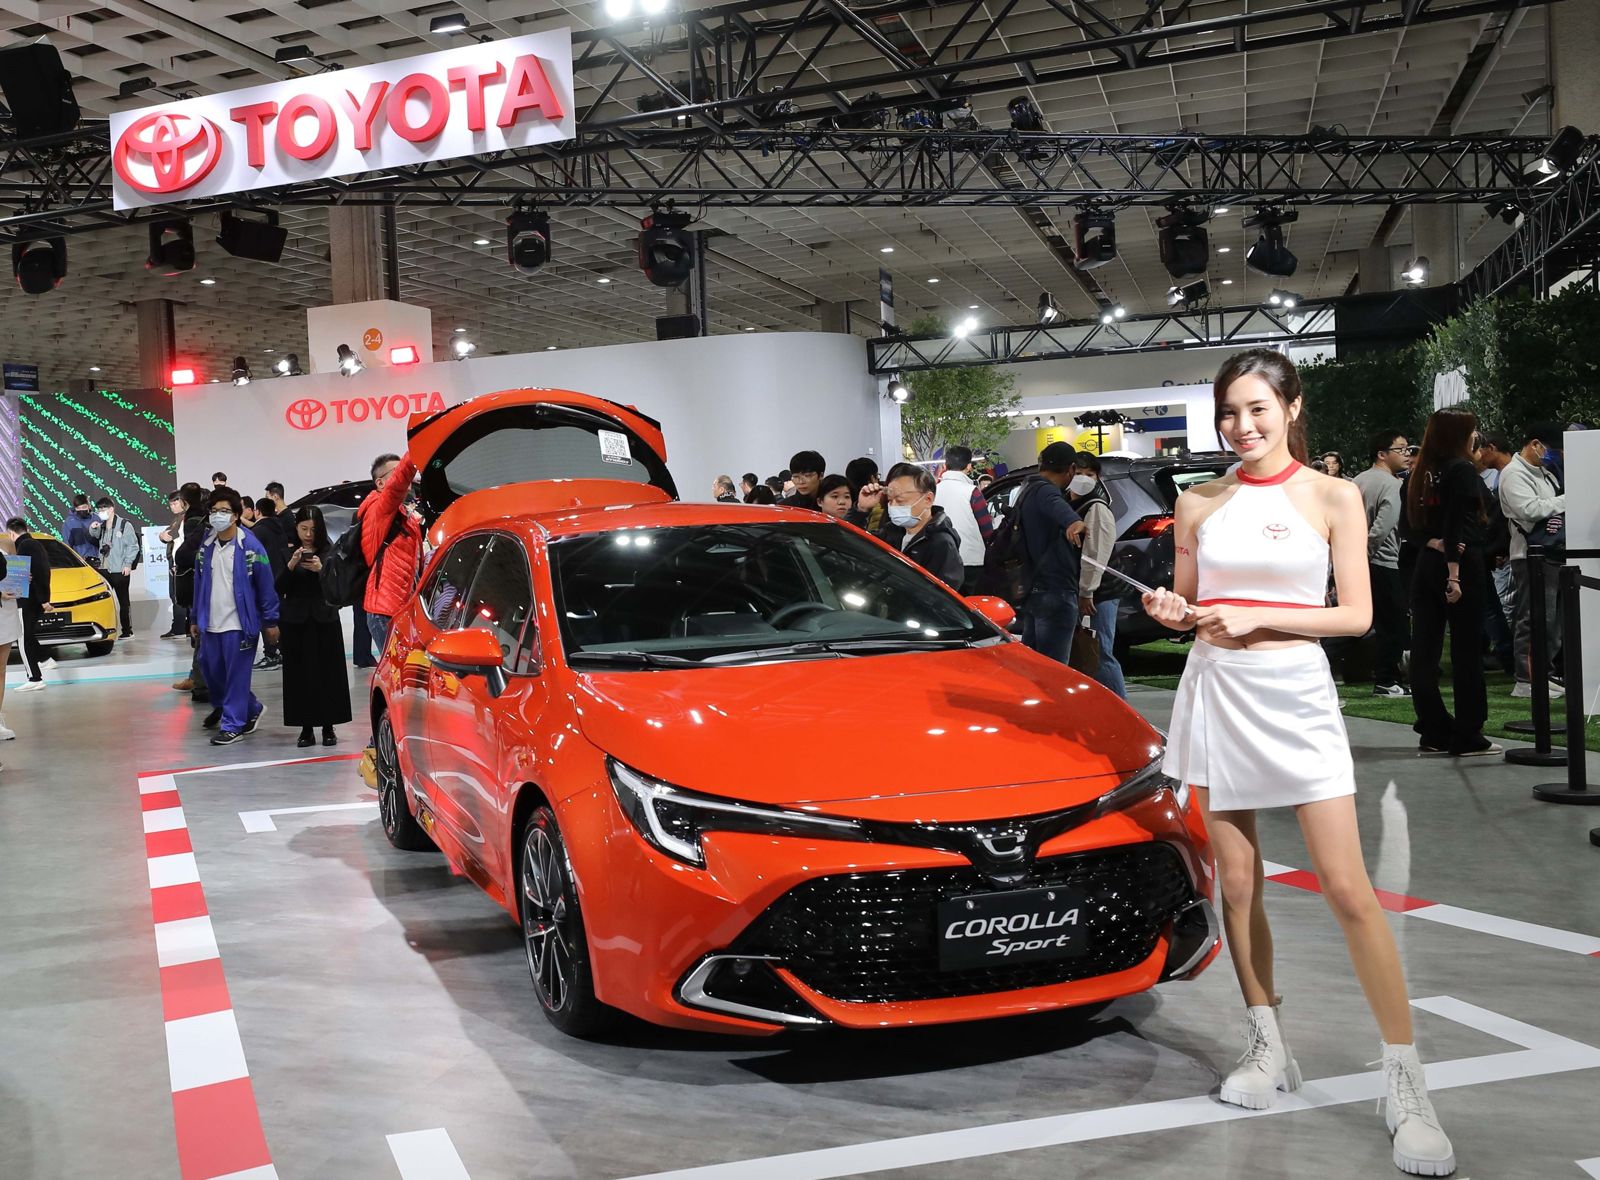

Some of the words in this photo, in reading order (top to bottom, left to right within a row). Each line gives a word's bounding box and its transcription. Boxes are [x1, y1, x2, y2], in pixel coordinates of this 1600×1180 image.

[229, 53, 565, 168] TOYOTA
[364, 333, 382, 346] 2-4
[330, 391, 447, 424] TOYOTA
[149, 554, 167, 563] 14:
[944, 908, 1079, 939] COROLLA
[985, 934, 1071, 956] Sport
